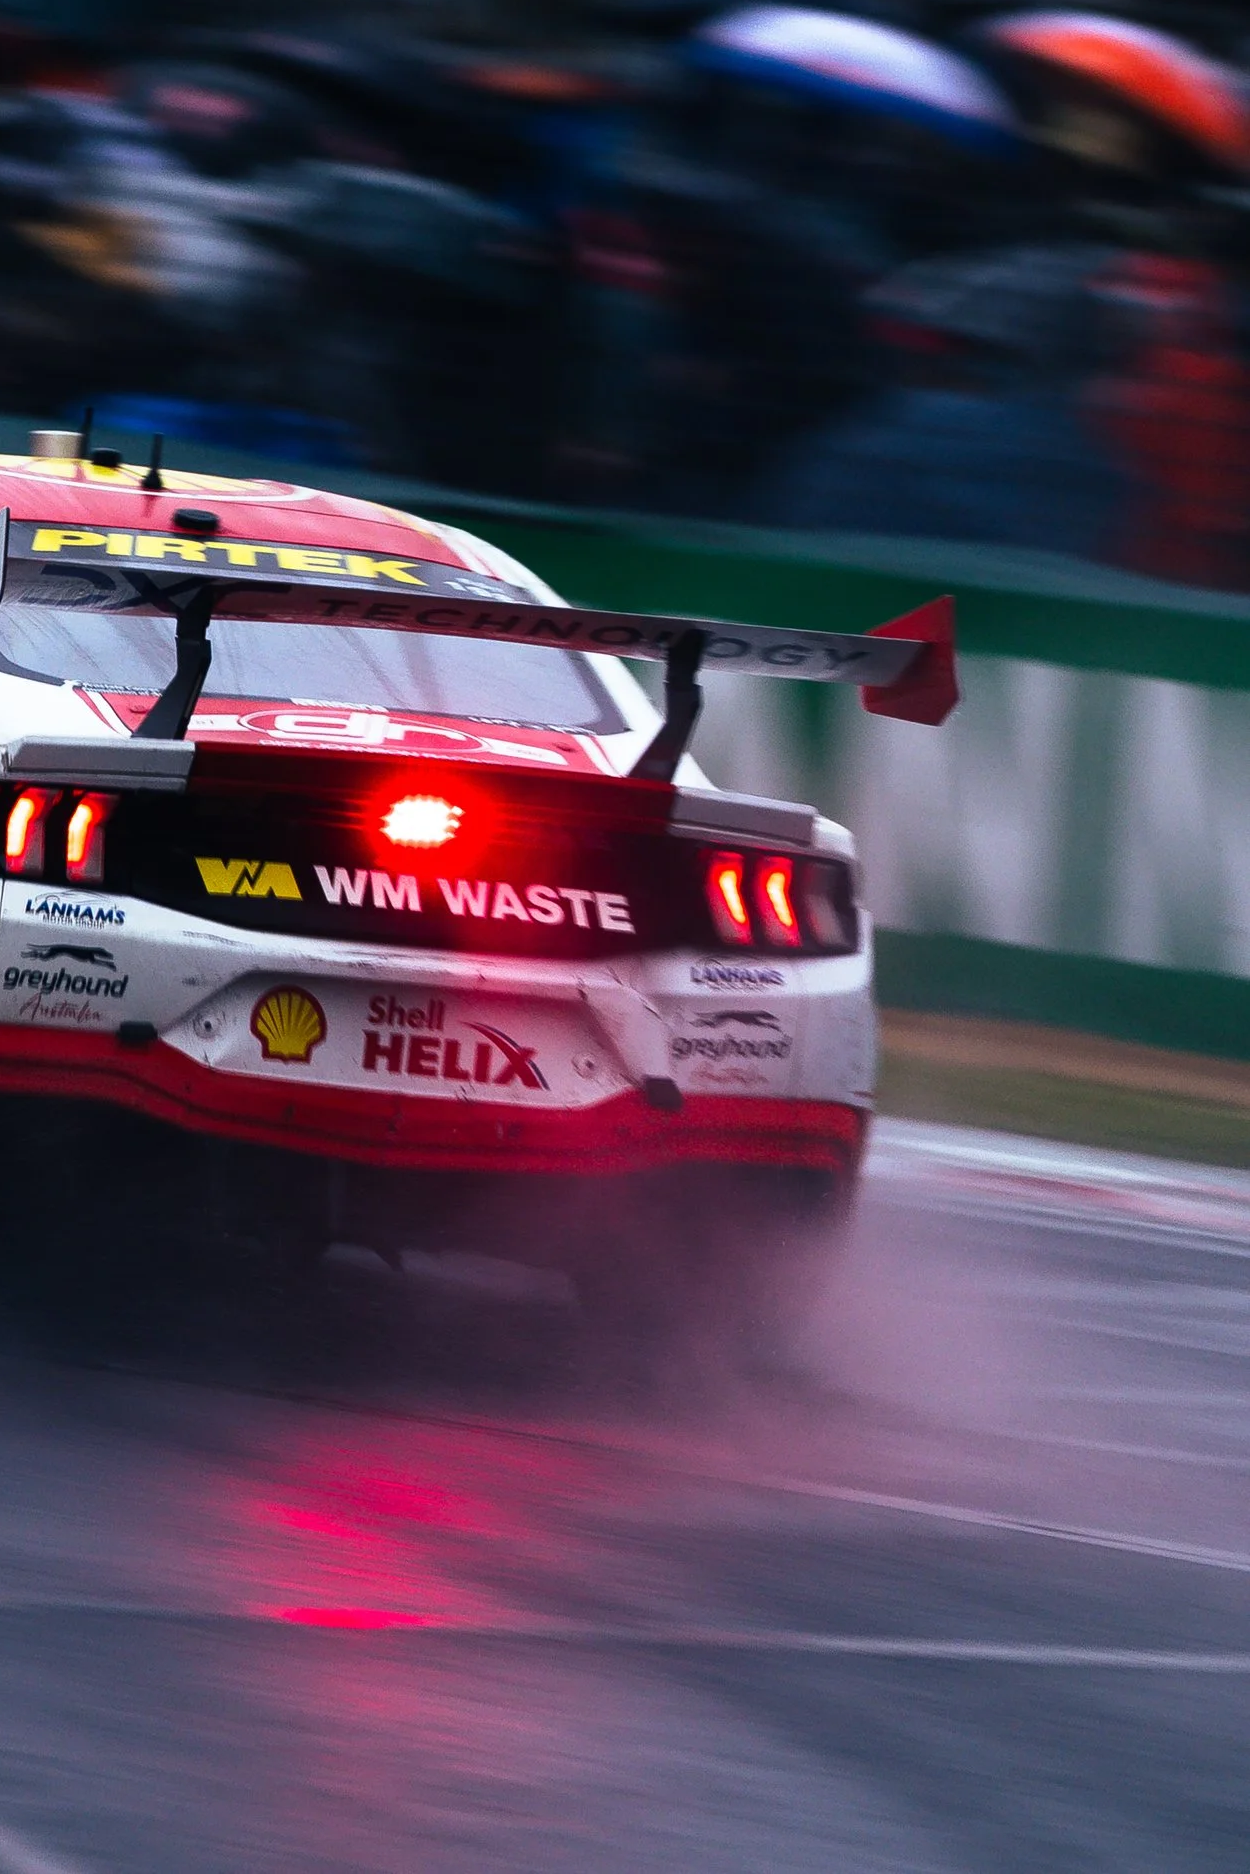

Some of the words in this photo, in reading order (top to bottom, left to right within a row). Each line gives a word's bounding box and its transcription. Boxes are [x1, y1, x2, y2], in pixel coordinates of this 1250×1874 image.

[31, 528, 429, 587] PIRTEK
[318, 598, 872, 668] TECHNOOGY
[313, 864, 423, 913] WM
[437, 877, 637, 934] WASTE
[3, 966, 129, 999] greyhound
[367, 994, 447, 1032] Shell
[362, 1022, 549, 1091] HELIX
